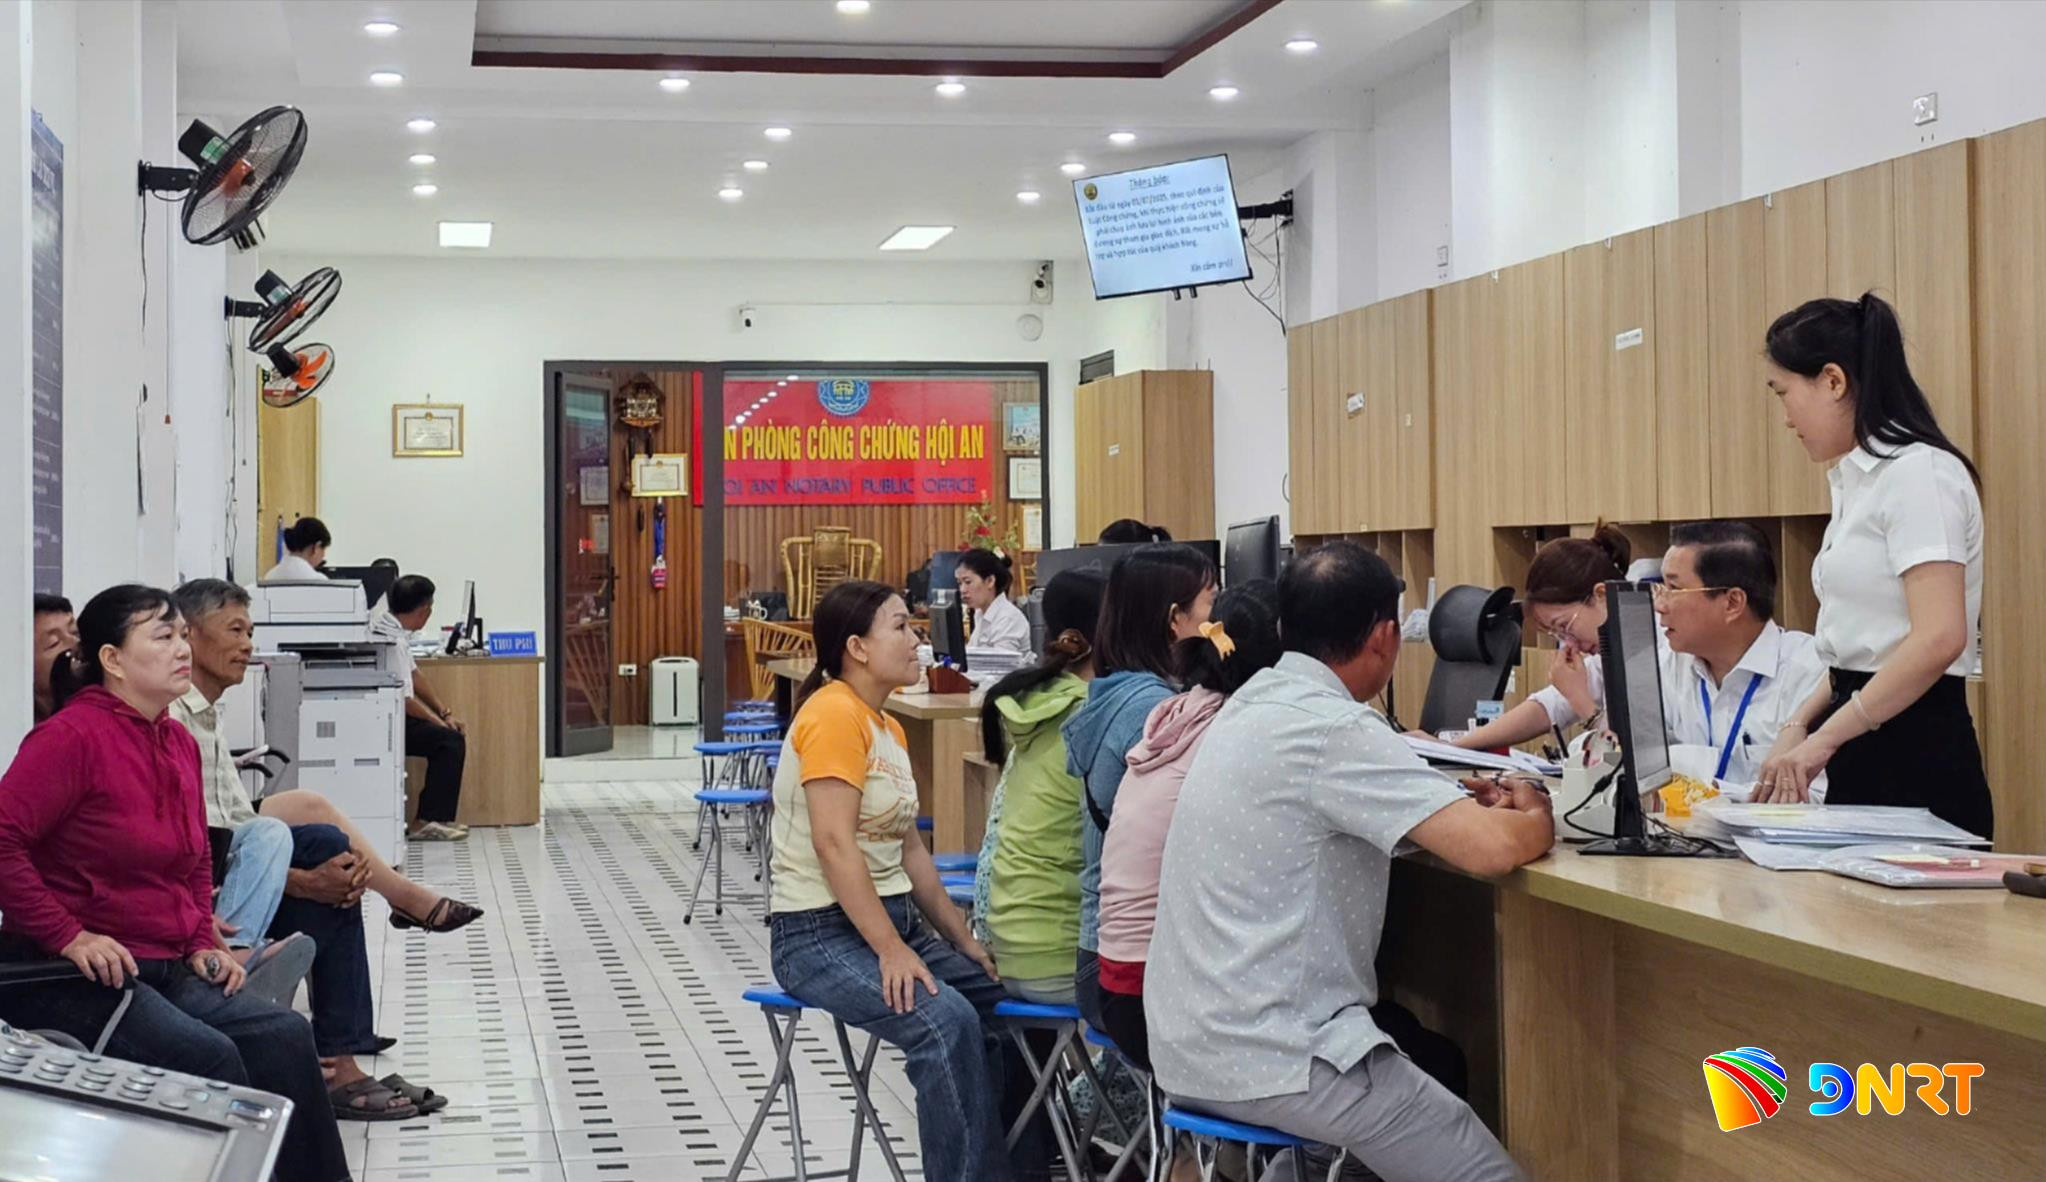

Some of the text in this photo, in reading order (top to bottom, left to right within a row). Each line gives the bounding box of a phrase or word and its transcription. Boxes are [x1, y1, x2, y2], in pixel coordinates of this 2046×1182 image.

[741, 418, 801, 460] PHÒNG
[807, 418, 854, 460] CÔNG
[860, 418, 920, 460] CHỨNG
[925, 417, 954, 466] HỘI
[959, 424, 984, 460] AN
[724, 479, 743, 495] OI
[785, 477, 851, 494] NOTARY
[862, 477, 914, 494] PUBLIC
[923, 477, 977, 494] OFFICE
